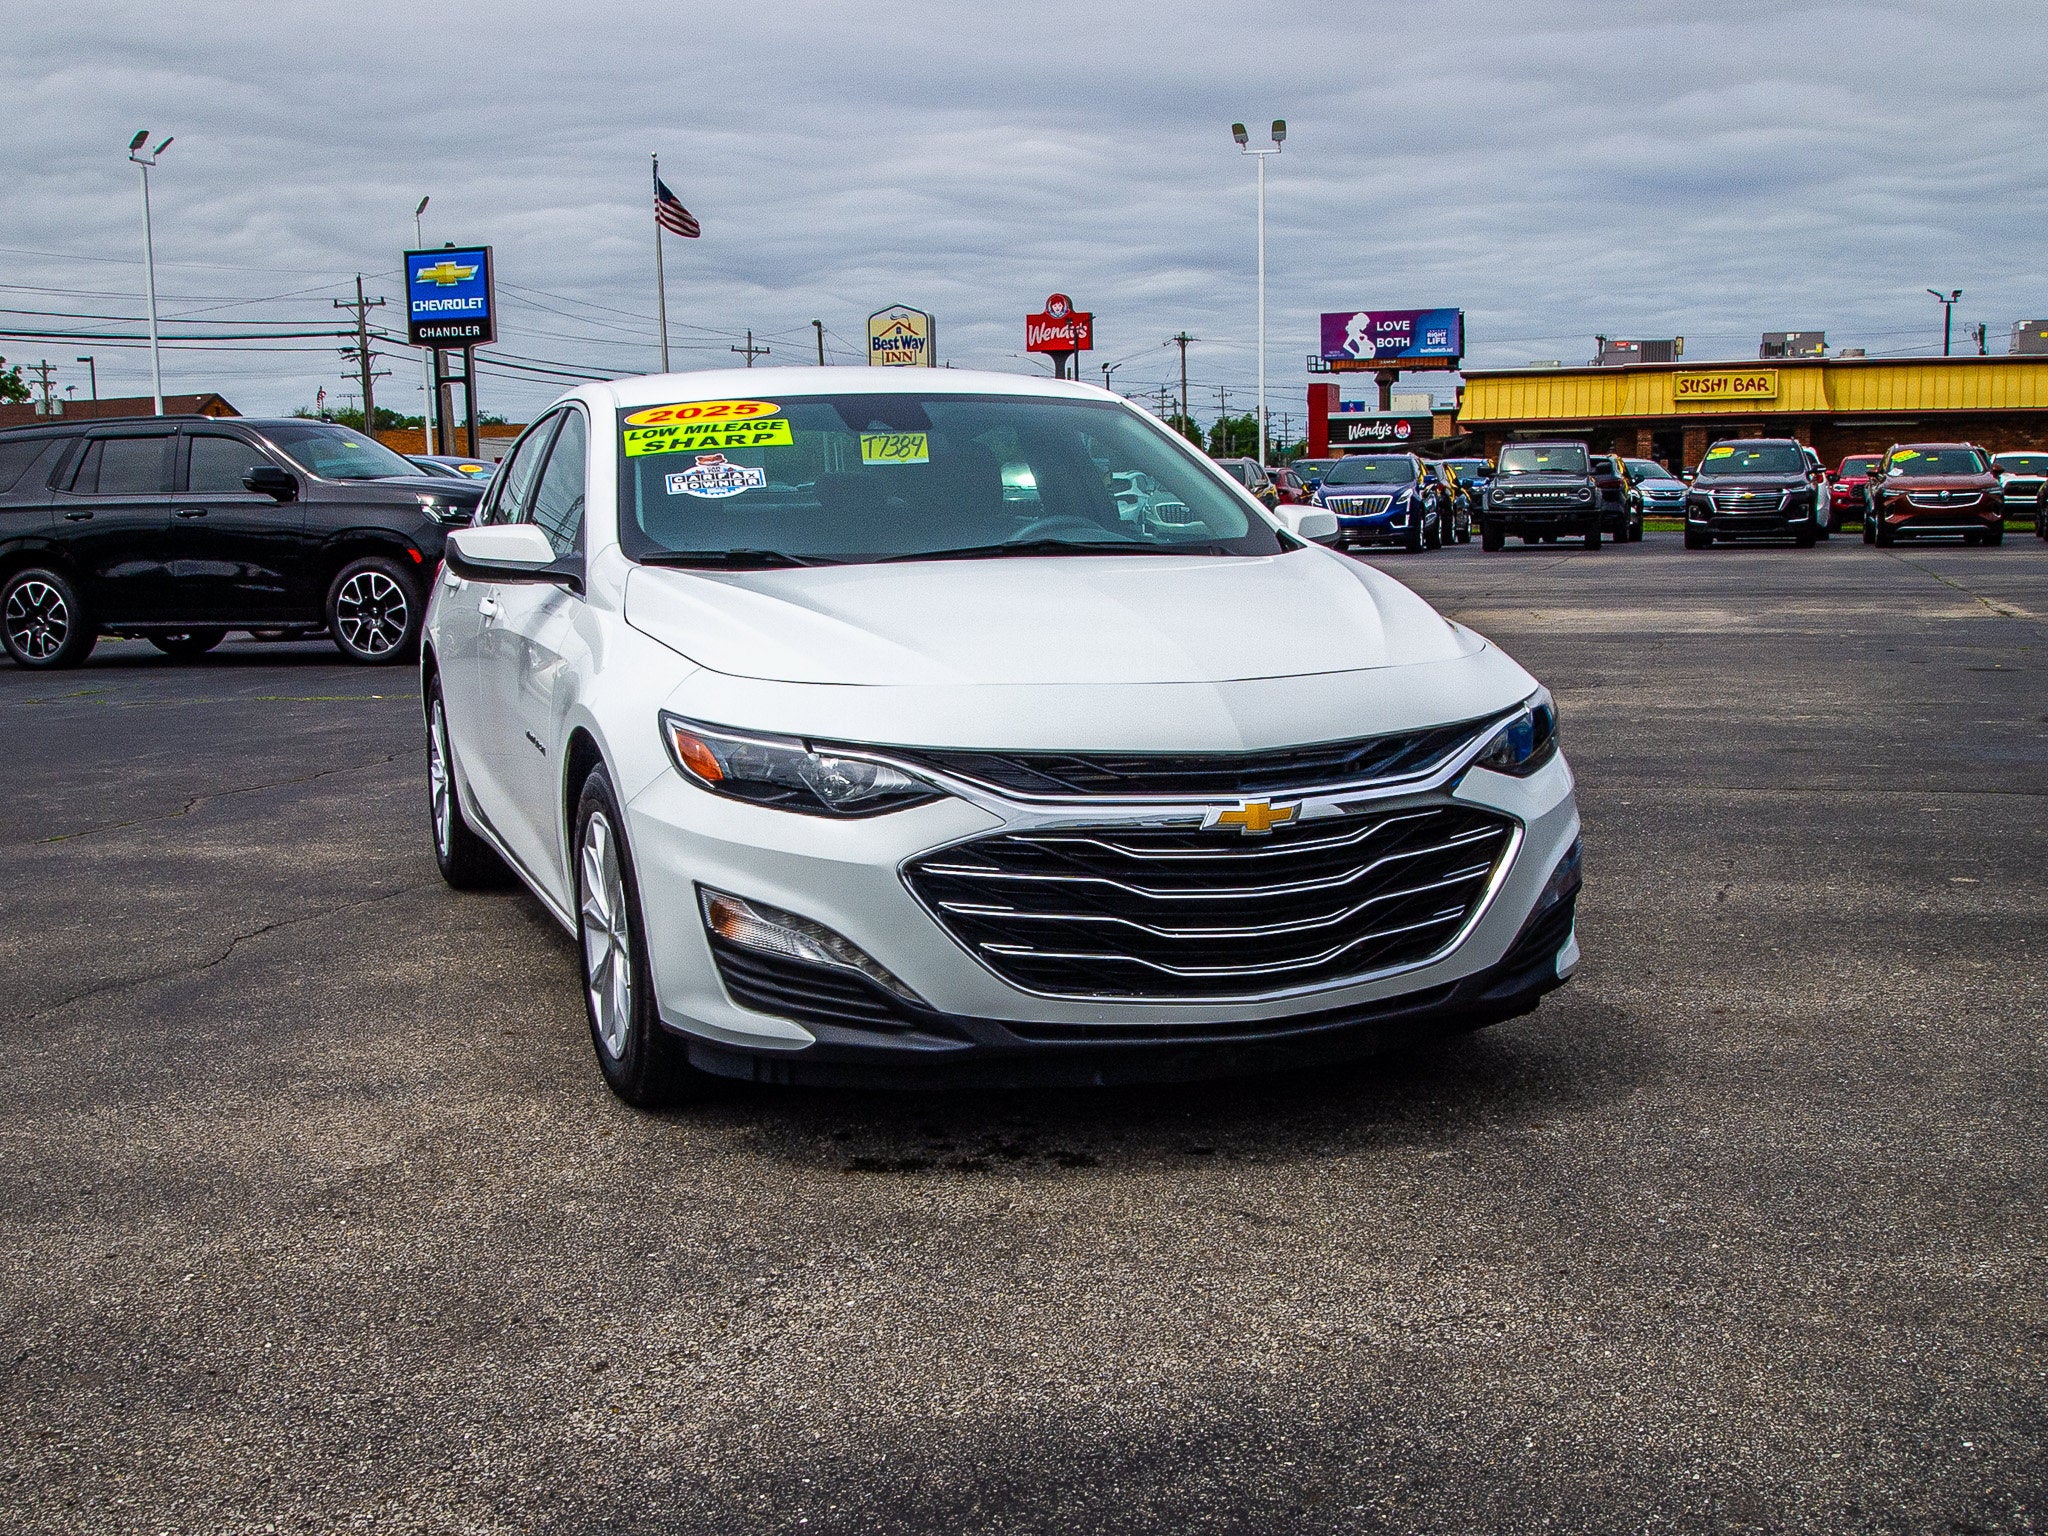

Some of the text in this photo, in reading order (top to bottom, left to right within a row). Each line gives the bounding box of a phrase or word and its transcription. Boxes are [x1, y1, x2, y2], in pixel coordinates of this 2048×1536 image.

[412, 297, 484, 312] CHEVROLET
[419, 325, 481, 338] CHANDLER
[1028, 321, 1088, 347] Wendy's
[1376, 320, 1410, 332] LOVE
[872, 335, 926, 353] Best Way
[1376, 337, 1410, 348] BOTH
[1427, 337, 1447, 345] LIFE
[885, 350, 914, 363] INN
[1679, 377, 1770, 394] SUSHI BAR
[650, 403, 761, 424] 2025
[628, 420, 785, 441] LOW MILEAGE
[1348, 421, 1392, 440] Wendy's
[642, 432, 775, 451] SHARP
[862, 435, 923, 459] T7384
[673, 472, 757, 483] CARFAX
[688, 478, 759, 490] OWNER
